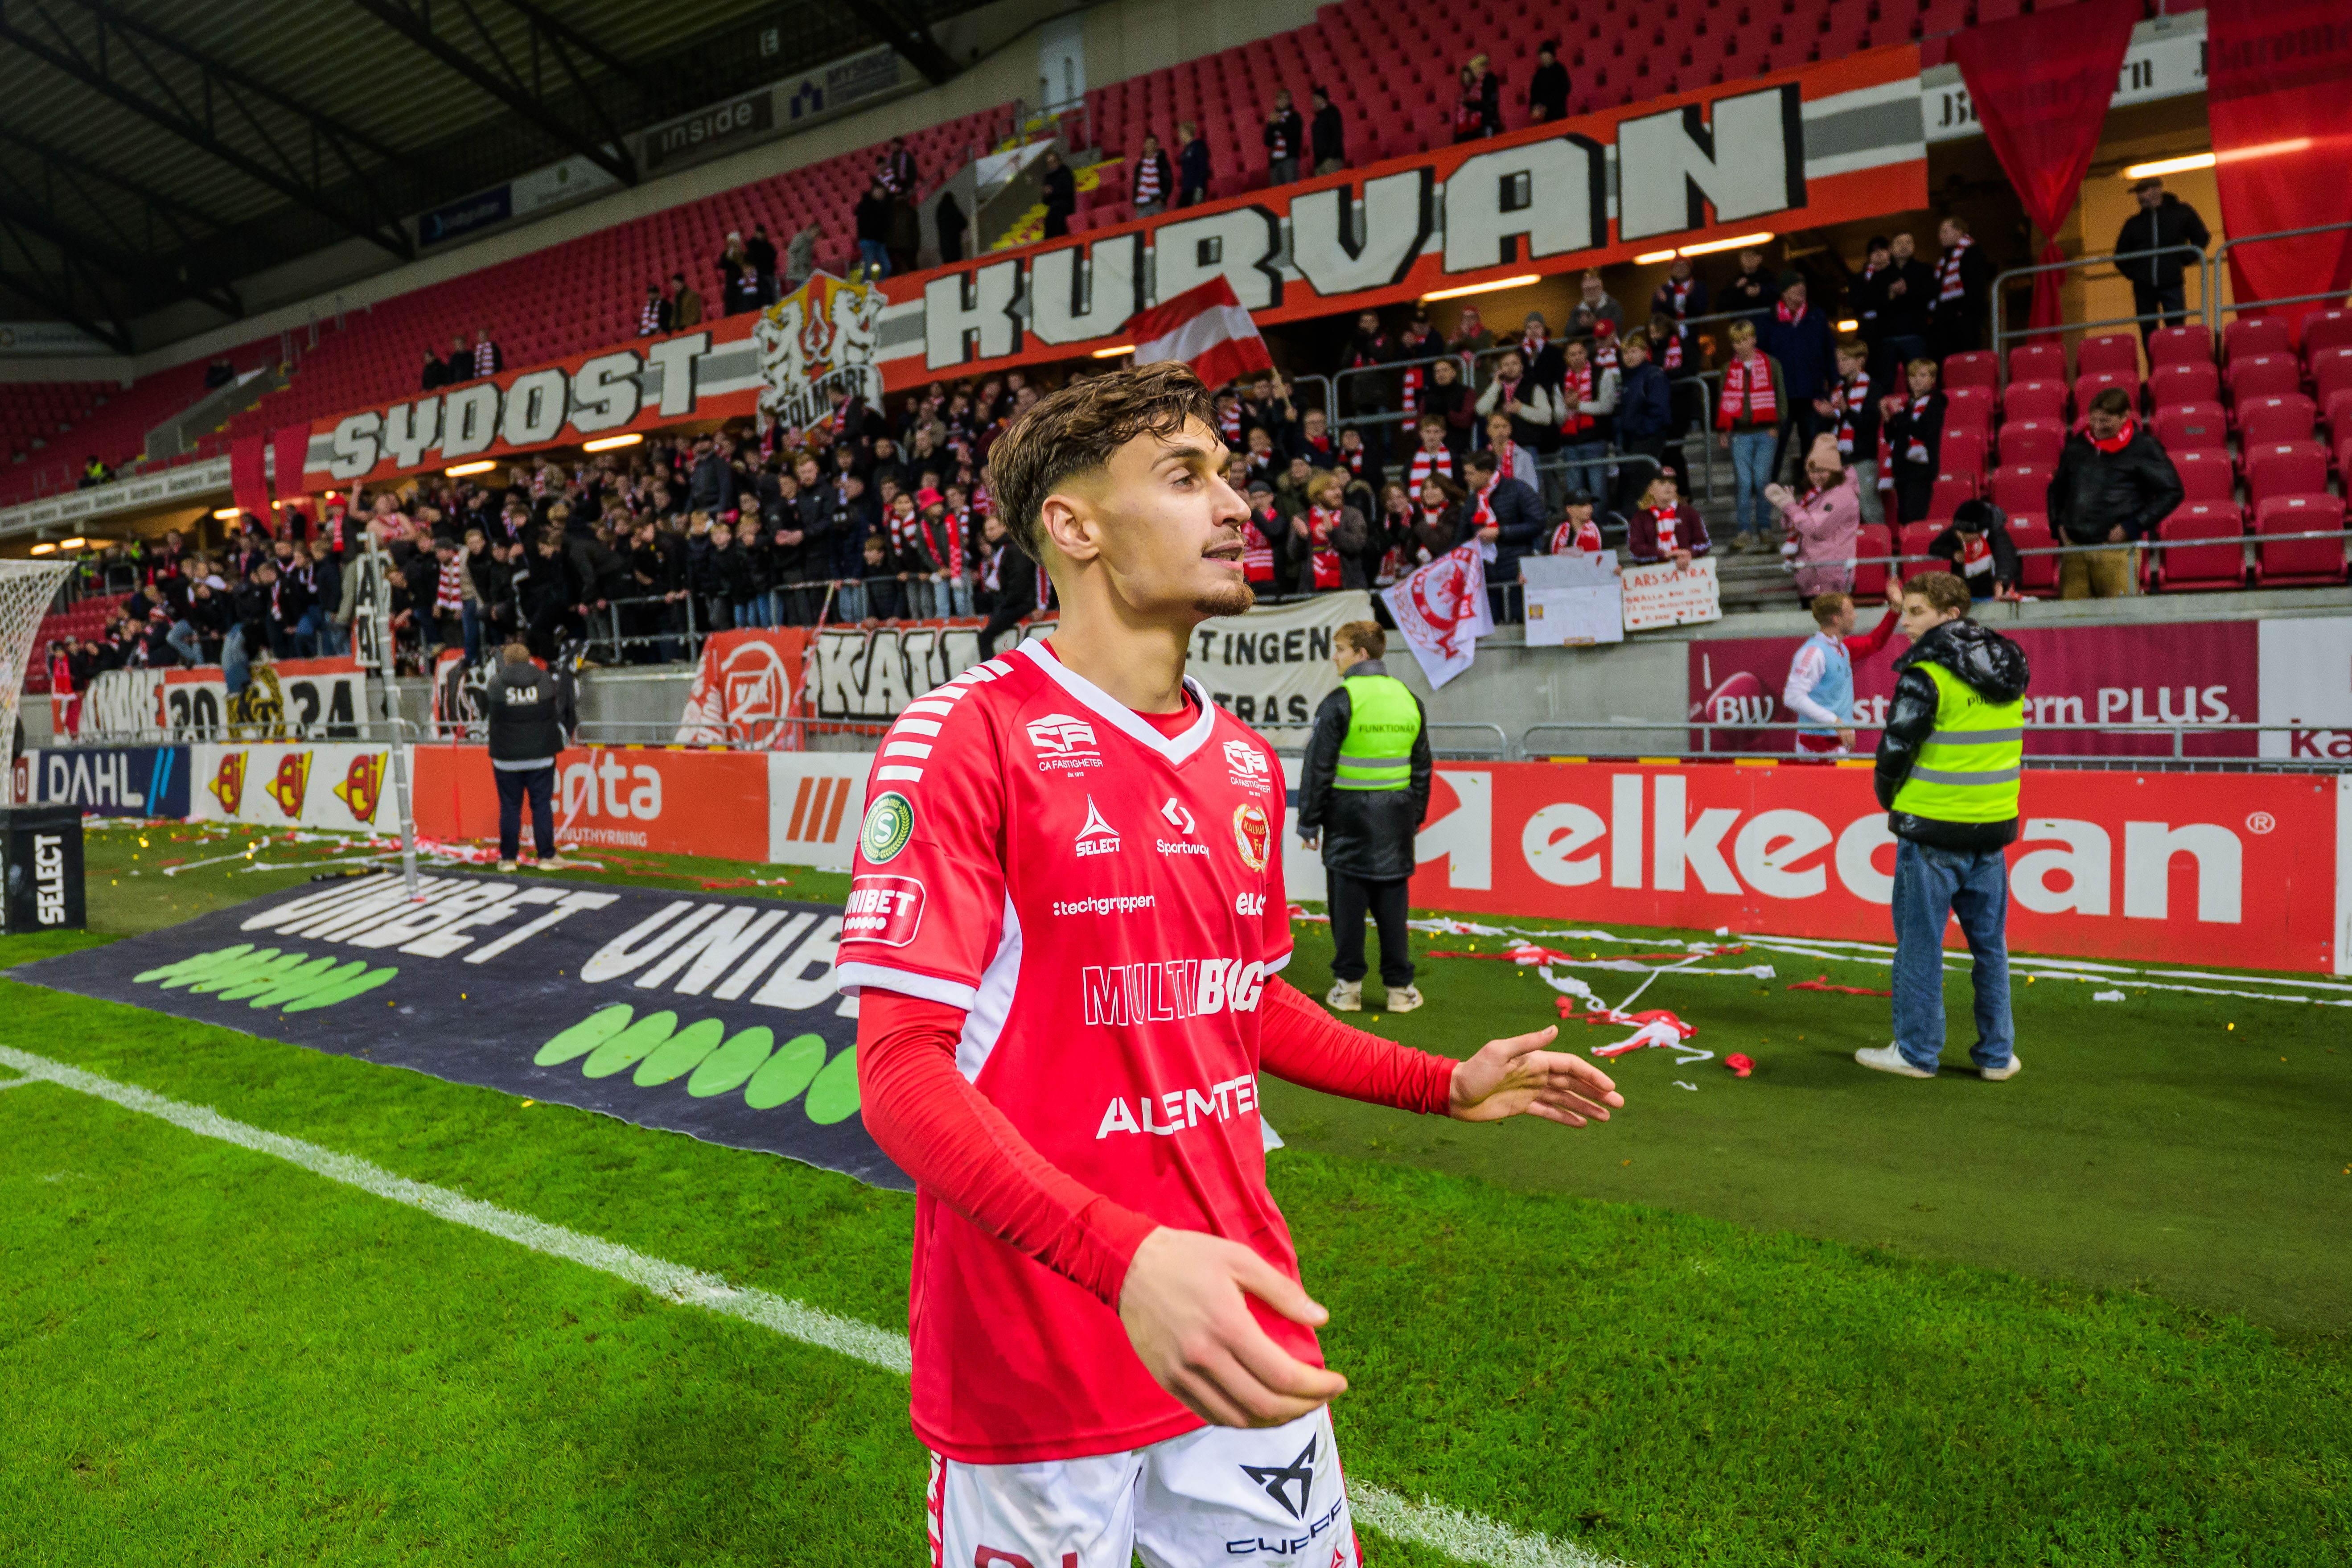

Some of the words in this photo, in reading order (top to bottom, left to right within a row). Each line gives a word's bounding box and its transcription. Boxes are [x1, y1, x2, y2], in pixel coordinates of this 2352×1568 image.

[661, 103, 752, 152] inside
[924, 83, 1807, 371] KURVAN
[331, 332, 711, 480] SYDOST
[1186, 626, 1332, 665] TINGEN
[1213, 694, 1309, 729] TRAS
[1716, 695, 1774, 724] BW
[2097, 685, 2230, 723] PLUS
[48, 753, 144, 808] DAHL
[551, 752, 662, 821] nta
[1039, 761, 1052, 771] CA
[1052, 758, 1104, 769] FASTIGHETER
[1076, 837, 1120, 857] SELECT
[1156, 839, 1210, 859] Sportway
[1244, 820, 1266, 834] KALMAR
[1522, 774, 2242, 925] elkean
[34, 833, 66, 925] SELECT
[241, 872, 621, 964] UNIBET
[580, 900, 859, 1019] UNIB
